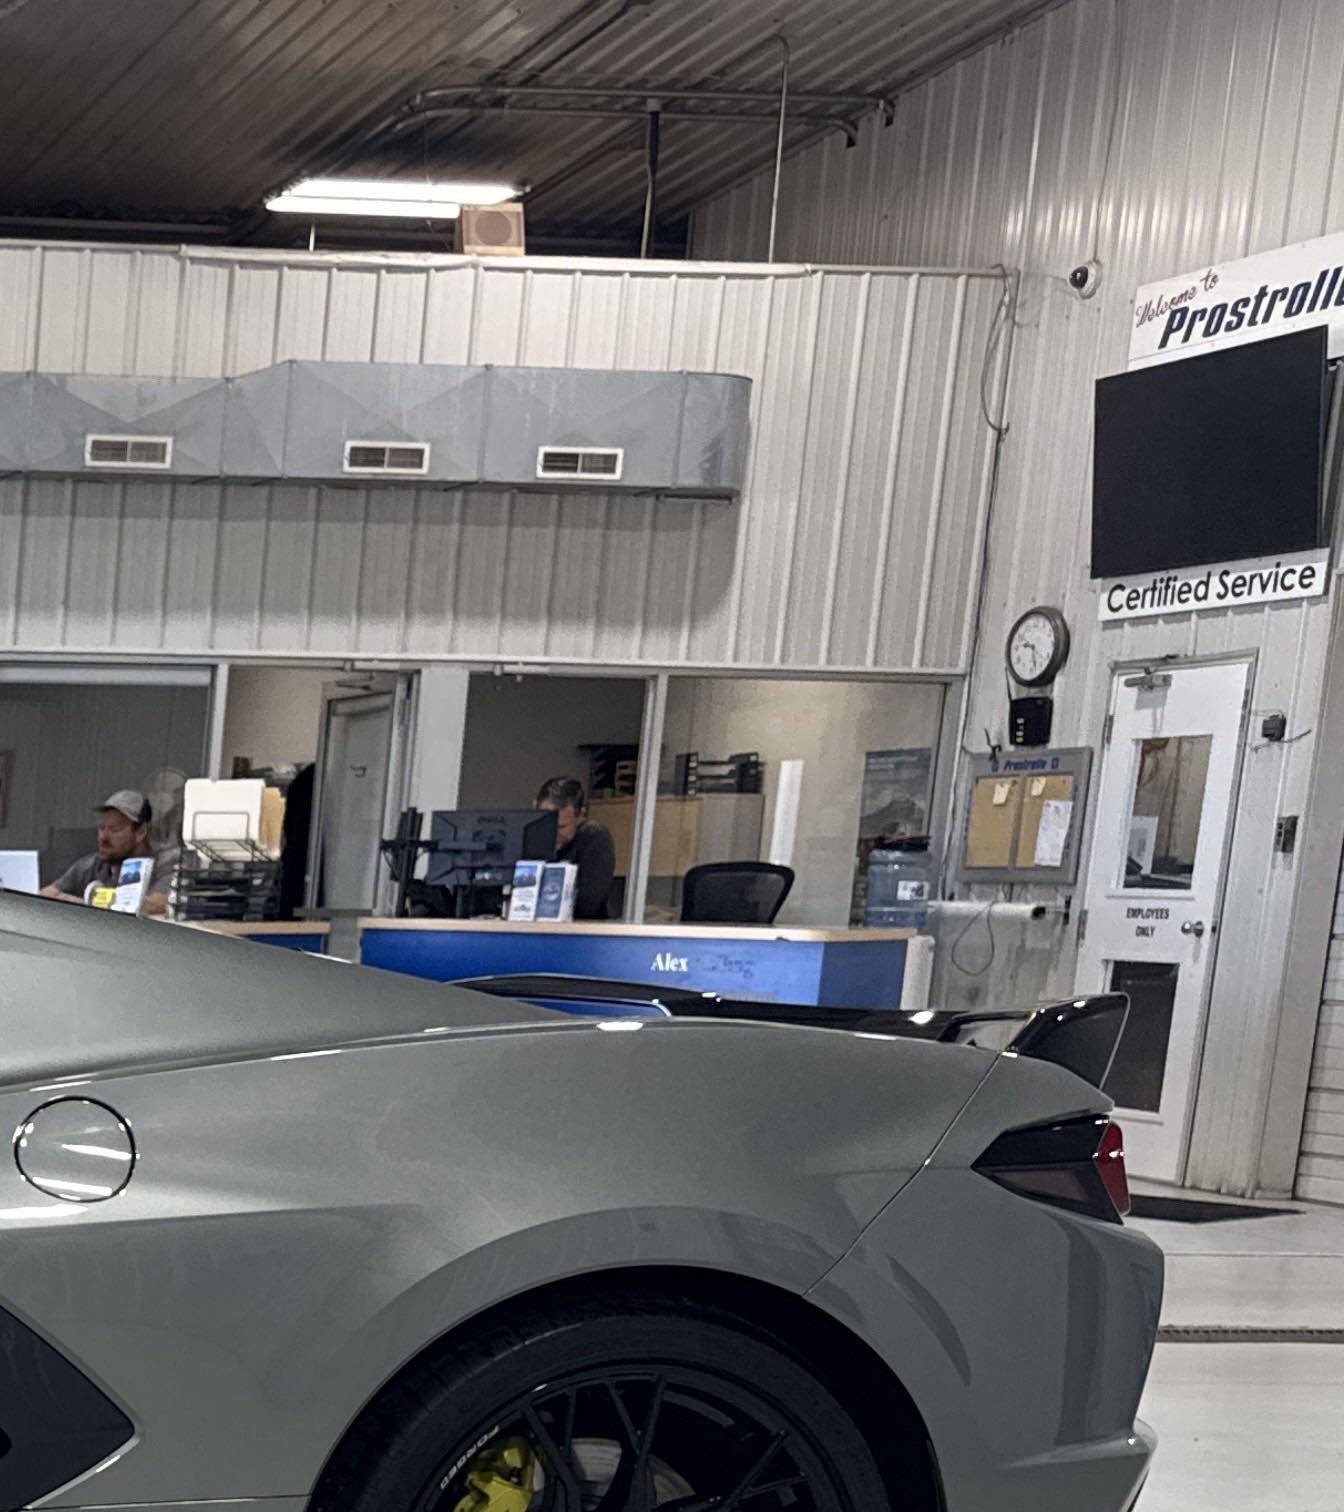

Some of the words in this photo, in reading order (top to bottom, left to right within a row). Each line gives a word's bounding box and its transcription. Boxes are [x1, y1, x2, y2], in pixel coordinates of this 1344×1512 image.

[1136, 284, 1198, 328] Welcome
[1200, 268, 1220, 293] to
[1107, 571, 1212, 613] Certified
[1216, 561, 1316, 601] Service
[1126, 907, 1170, 920] EMPLOYEES
[1135, 925, 1156, 937] ONLY
[651, 952, 688, 972] Alex
[440, 1424, 500, 1491] FORGED
